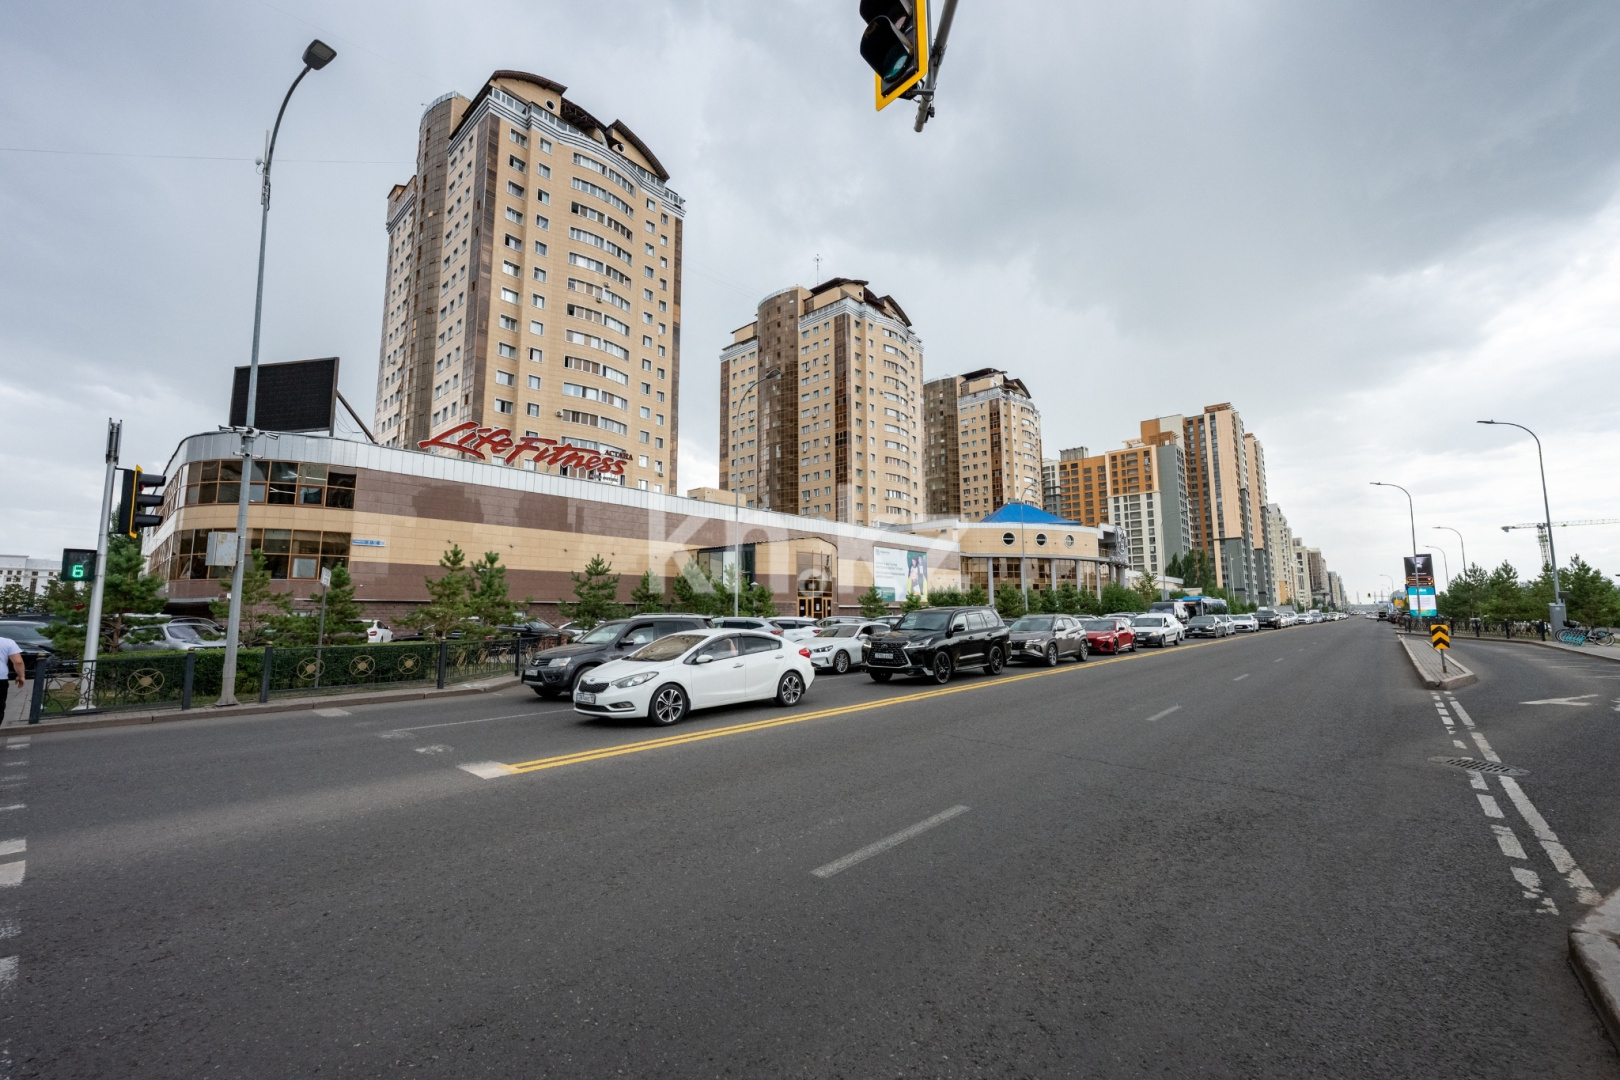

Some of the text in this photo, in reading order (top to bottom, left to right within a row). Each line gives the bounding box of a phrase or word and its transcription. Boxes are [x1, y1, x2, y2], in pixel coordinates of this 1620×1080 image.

[418, 421, 627, 475] Life Fitness
[72, 564, 84, 578] 6
